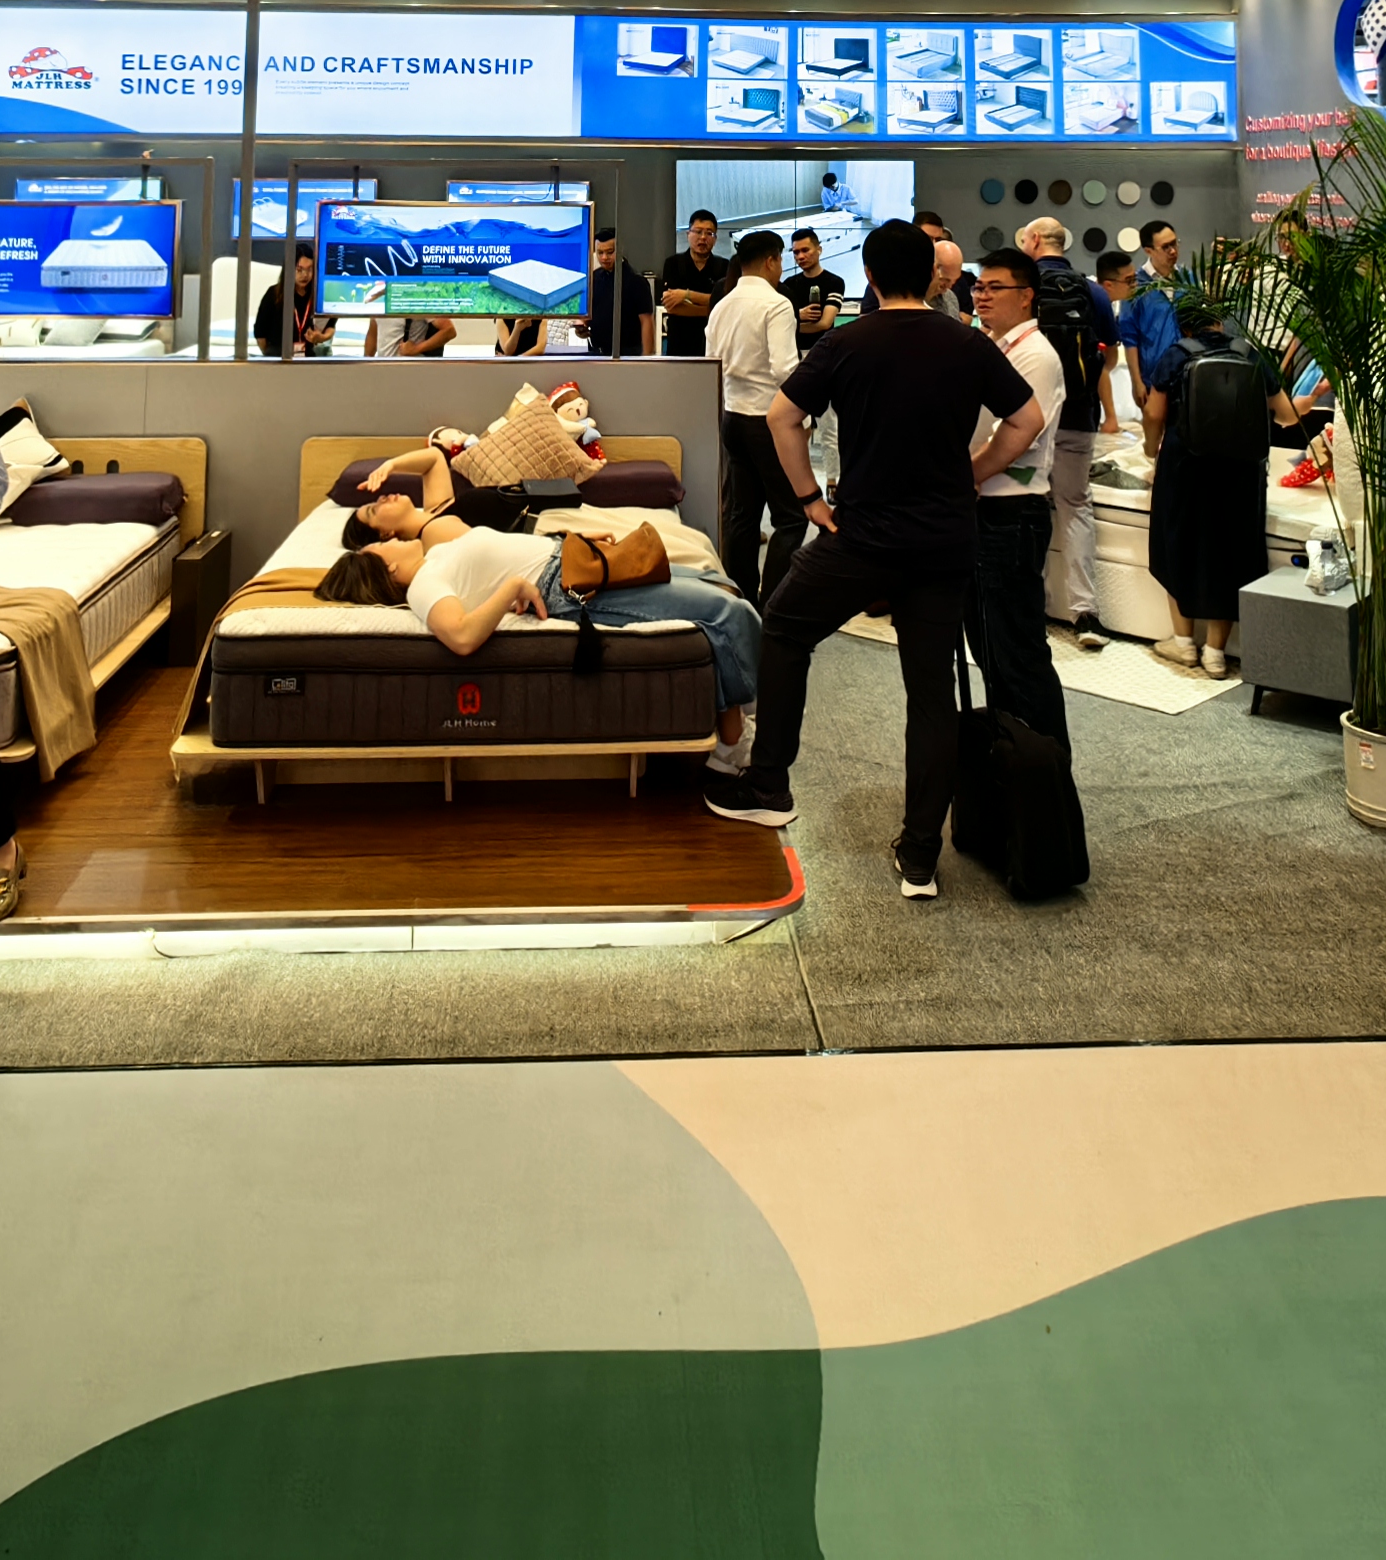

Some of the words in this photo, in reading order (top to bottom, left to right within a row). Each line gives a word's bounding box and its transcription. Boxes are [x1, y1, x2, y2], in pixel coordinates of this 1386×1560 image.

[120, 53, 242, 71] ELEGANC
[263, 55, 315, 72] AND
[322, 56, 534, 76] CRAFTSMANSHIP
[35, 72, 62, 81] JLH
[11, 81, 92, 90] MATTRESS
[119, 77, 196, 95] SINCE
[203, 78, 244, 96] 199
[1245, 111, 1305, 133] Customizing
[1307, 111, 1333, 133] your
[1266, 141, 1311, 161] boutique
[422, 245, 456, 255] DEFINE
[458, 245, 475, 254] THE
[477, 245, 511, 254] FUTURE
[422, 255, 446, 264] WITH
[448, 255, 512, 264] INNOVATION
